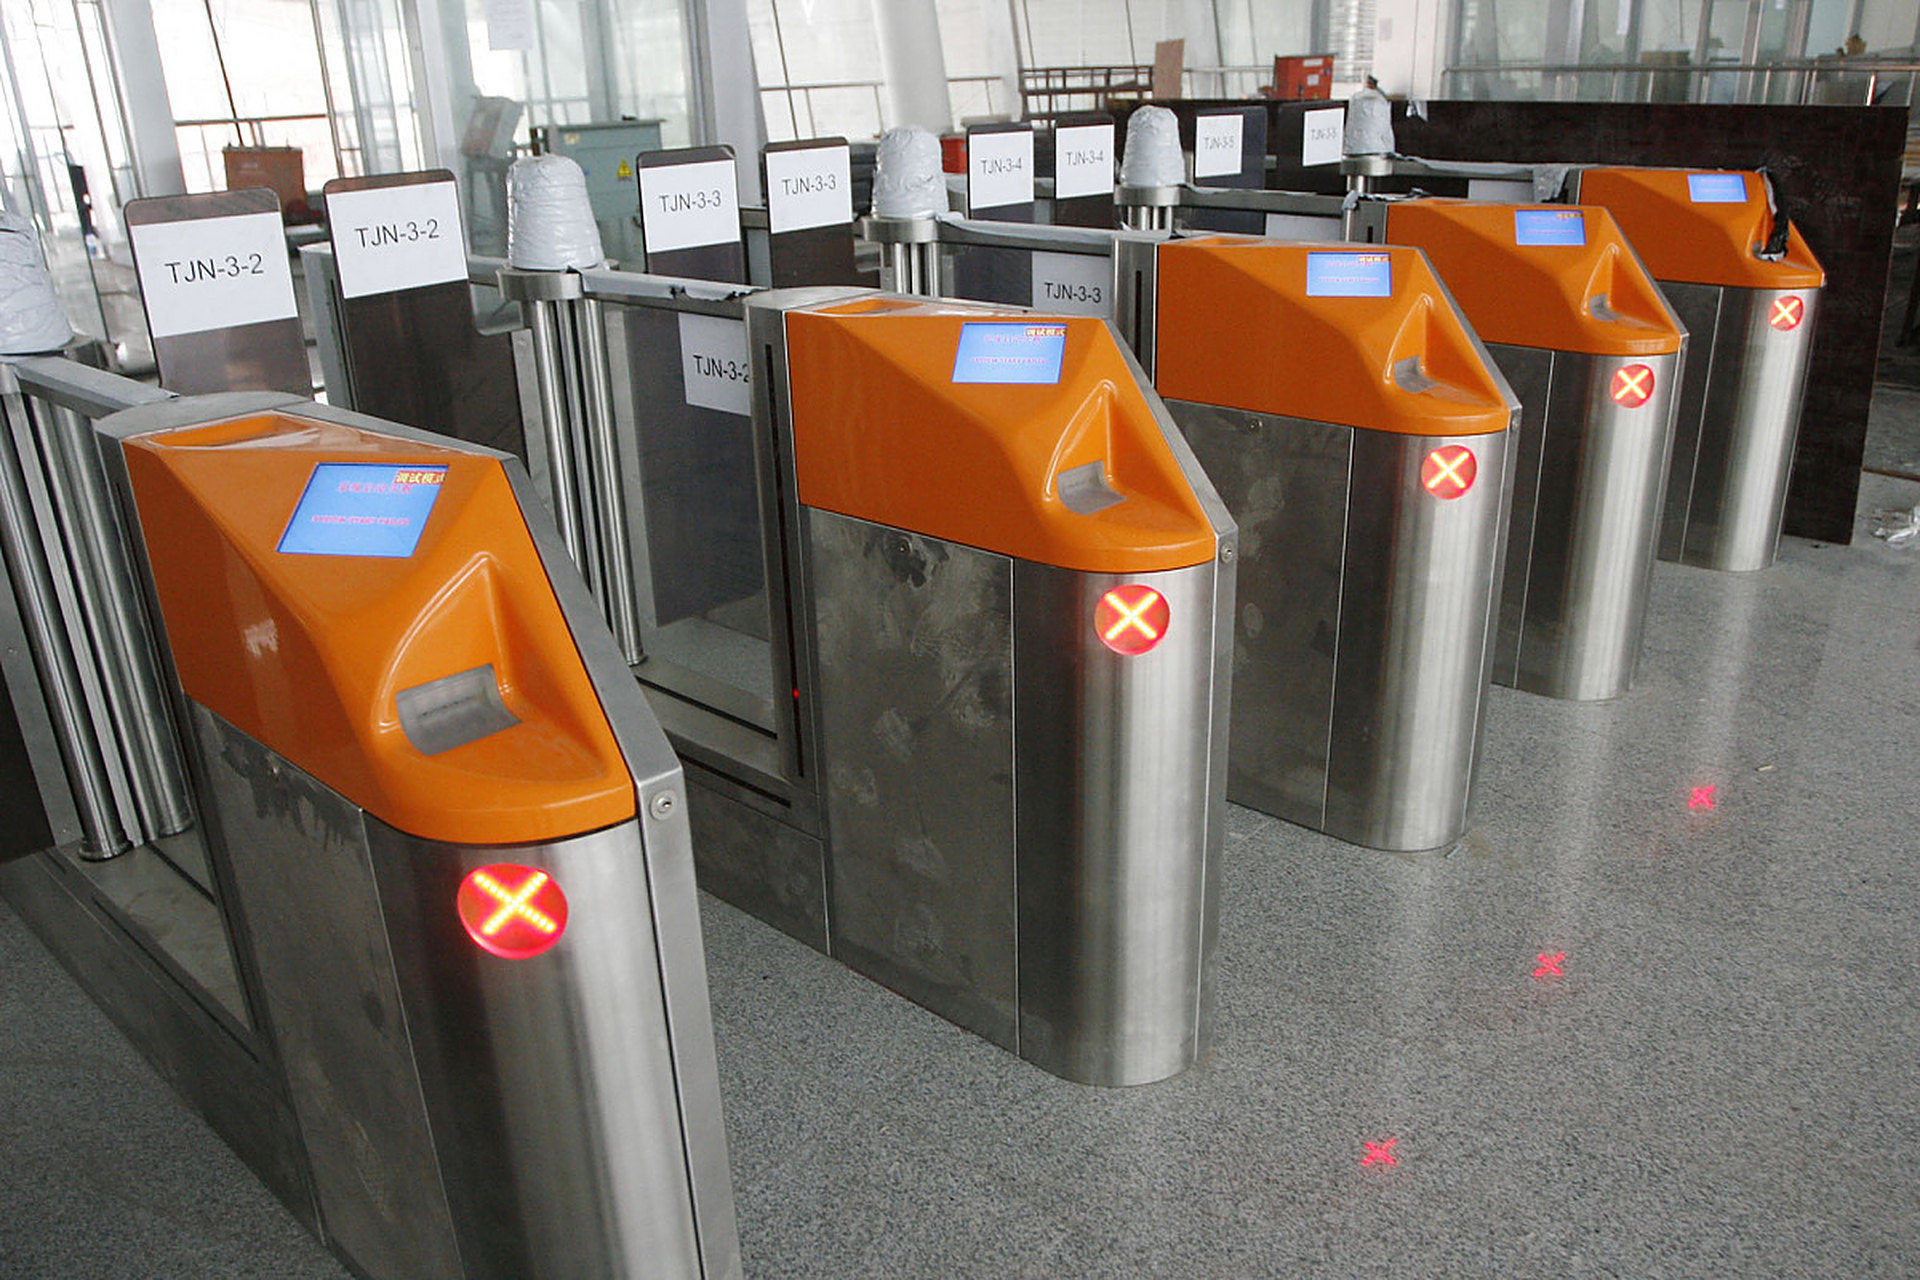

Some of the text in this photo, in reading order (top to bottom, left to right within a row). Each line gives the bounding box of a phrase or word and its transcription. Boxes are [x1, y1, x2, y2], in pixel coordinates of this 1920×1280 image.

[980, 157, 1023, 176] TJN-3-4
[1065, 149, 1105, 167] TJN-3-4
[781, 174, 837, 196] TJN-3-3
[658, 189, 722, 213] TJN-3-3
[354, 218, 440, 249] TJN-3-2
[165, 253, 265, 285] TJN-3-2
[1043, 281, 1103, 304] TJN-3-3
